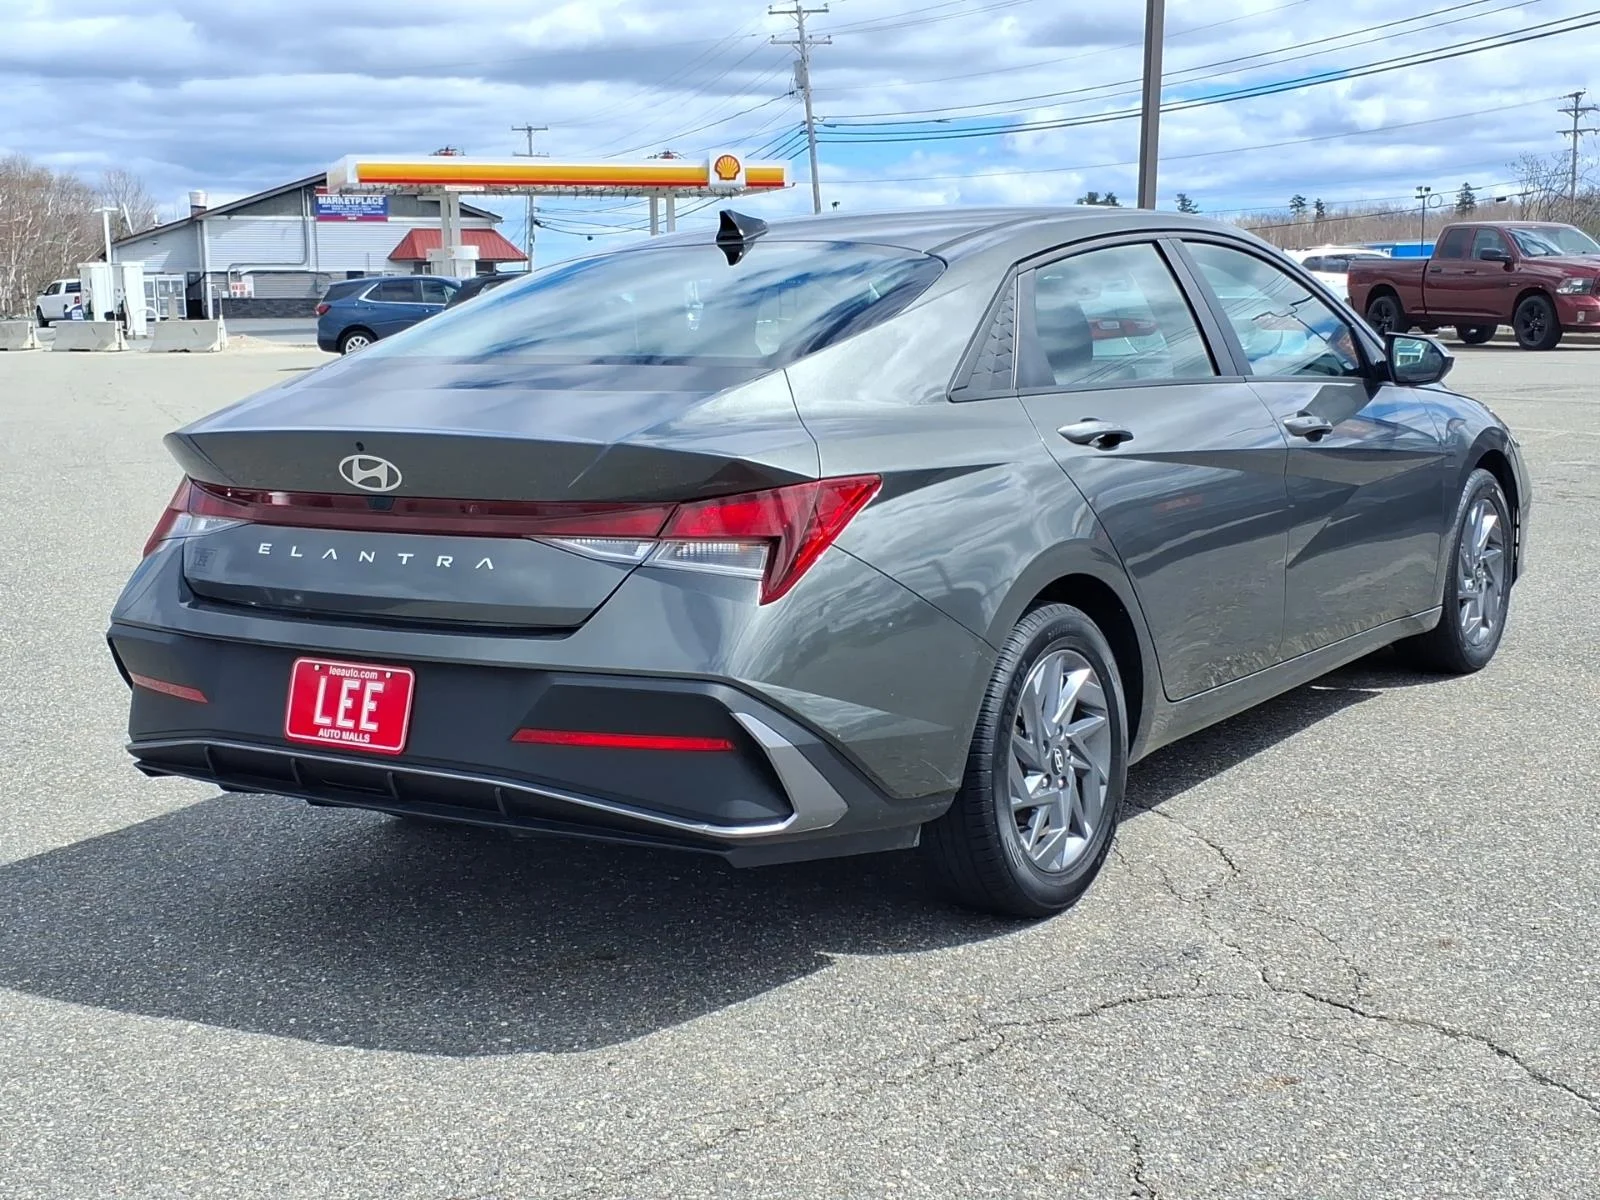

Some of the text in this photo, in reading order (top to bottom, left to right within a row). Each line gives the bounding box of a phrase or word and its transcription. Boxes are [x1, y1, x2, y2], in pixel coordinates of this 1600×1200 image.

[318, 197, 384, 205] MARKETPLACE
[258, 543, 494, 570] ELANTRA
[329, 666, 378, 679] leeauto.com
[313, 676, 385, 732] LEE
[318, 728, 370, 743] AUTO MALLS
